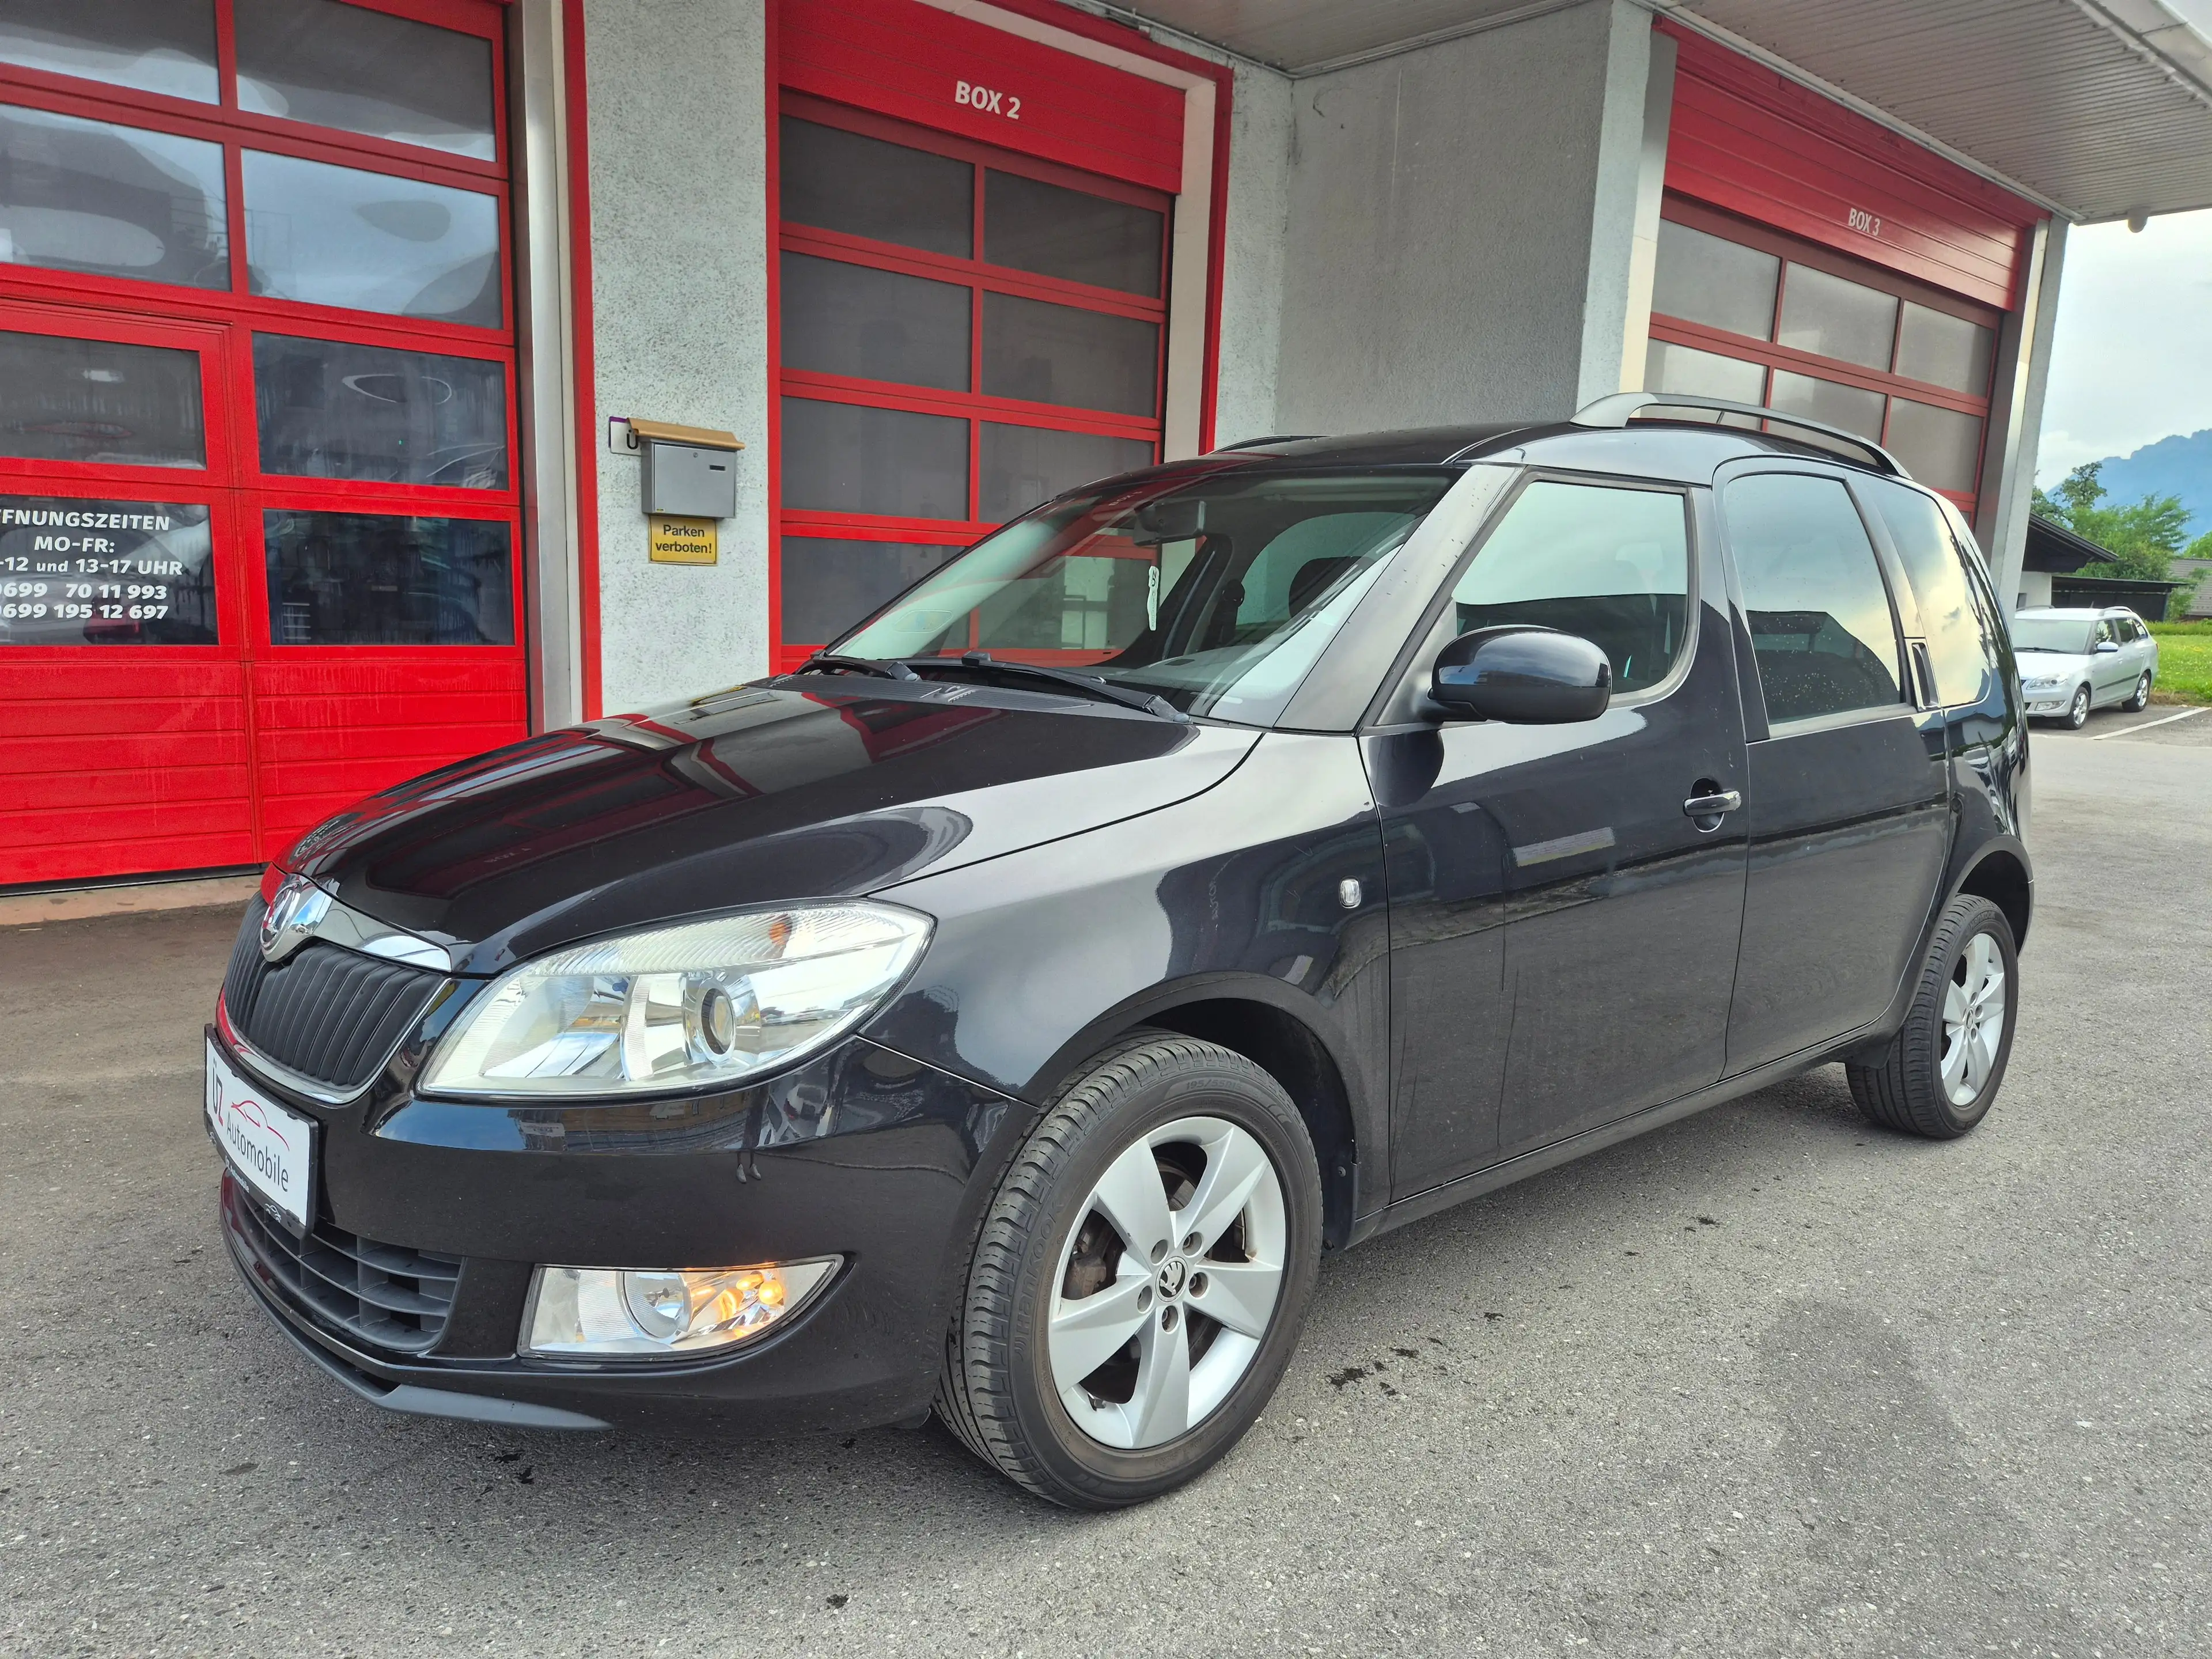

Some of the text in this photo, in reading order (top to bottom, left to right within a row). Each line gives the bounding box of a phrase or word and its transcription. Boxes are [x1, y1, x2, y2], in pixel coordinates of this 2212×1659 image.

[955, 81, 1021, 120] BOX 2
[1848, 207, 1880, 236] BOX 3
[0, 509, 170, 531] FNUNGSZEITEN
[663, 524, 704, 537] Parken
[34, 536, 115, 553] MO-FR:
[655, 541, 712, 554] verboten!
[36, 560, 69, 572] und
[75, 559, 131, 573] 13-17
[138, 560, 183, 575] UHR
[0, 582, 167, 600] 699 70 11 993
[0, 603, 169, 620] 699 195 12 697
[226, 1111, 289, 1192] Automobile
